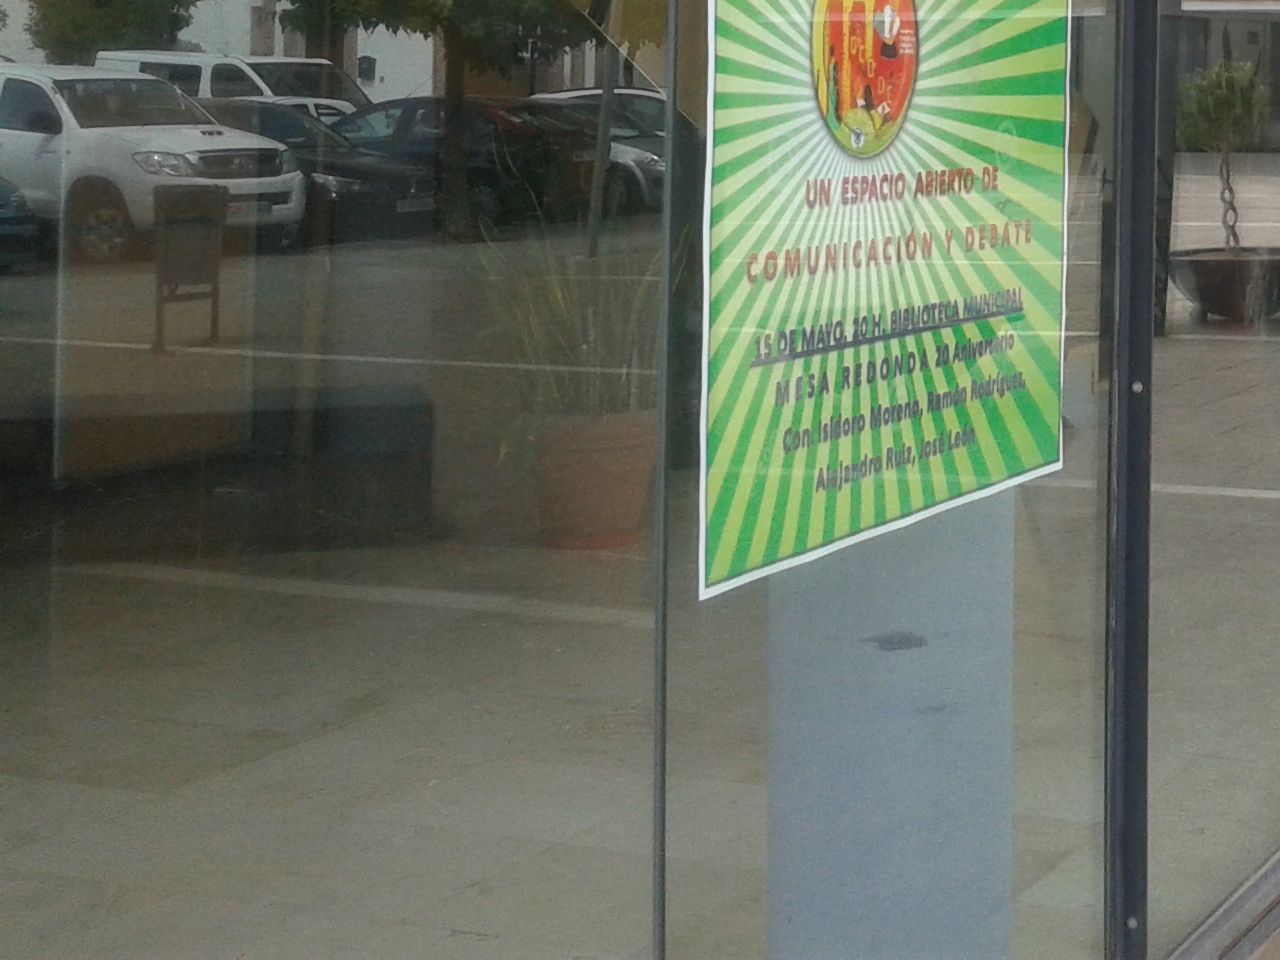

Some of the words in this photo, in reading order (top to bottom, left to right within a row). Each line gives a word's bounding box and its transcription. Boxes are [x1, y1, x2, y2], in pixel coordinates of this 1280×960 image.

[806, 177, 831, 208] UN
[842, 172, 905, 205] ESPACIO
[914, 167, 973, 198] ABIERTO
[982, 166, 999, 190] DE
[746, 230, 932, 283] COMUNICACIÓN
[945, 228, 954, 254] Y
[964, 218, 1032, 252] DEBATE
[777, 329, 796, 355] DE
[852, 316, 868, 340] 20
[872, 313, 885, 335] H.
[890, 299, 960, 331] BIBLIOTECA
[963, 287, 1023, 315] MUNICIPAL
[775, 371, 829, 406] MESA
[842, 349, 929, 389] REDONDA
[935, 344, 950, 367] 20
[783, 427, 811, 453] Con
[818, 413, 865, 443] Isidoro
[870, 399, 923, 429] Moreno,
[815, 453, 882, 493] Alejandro
[886, 442, 916, 469] Ruiz,
